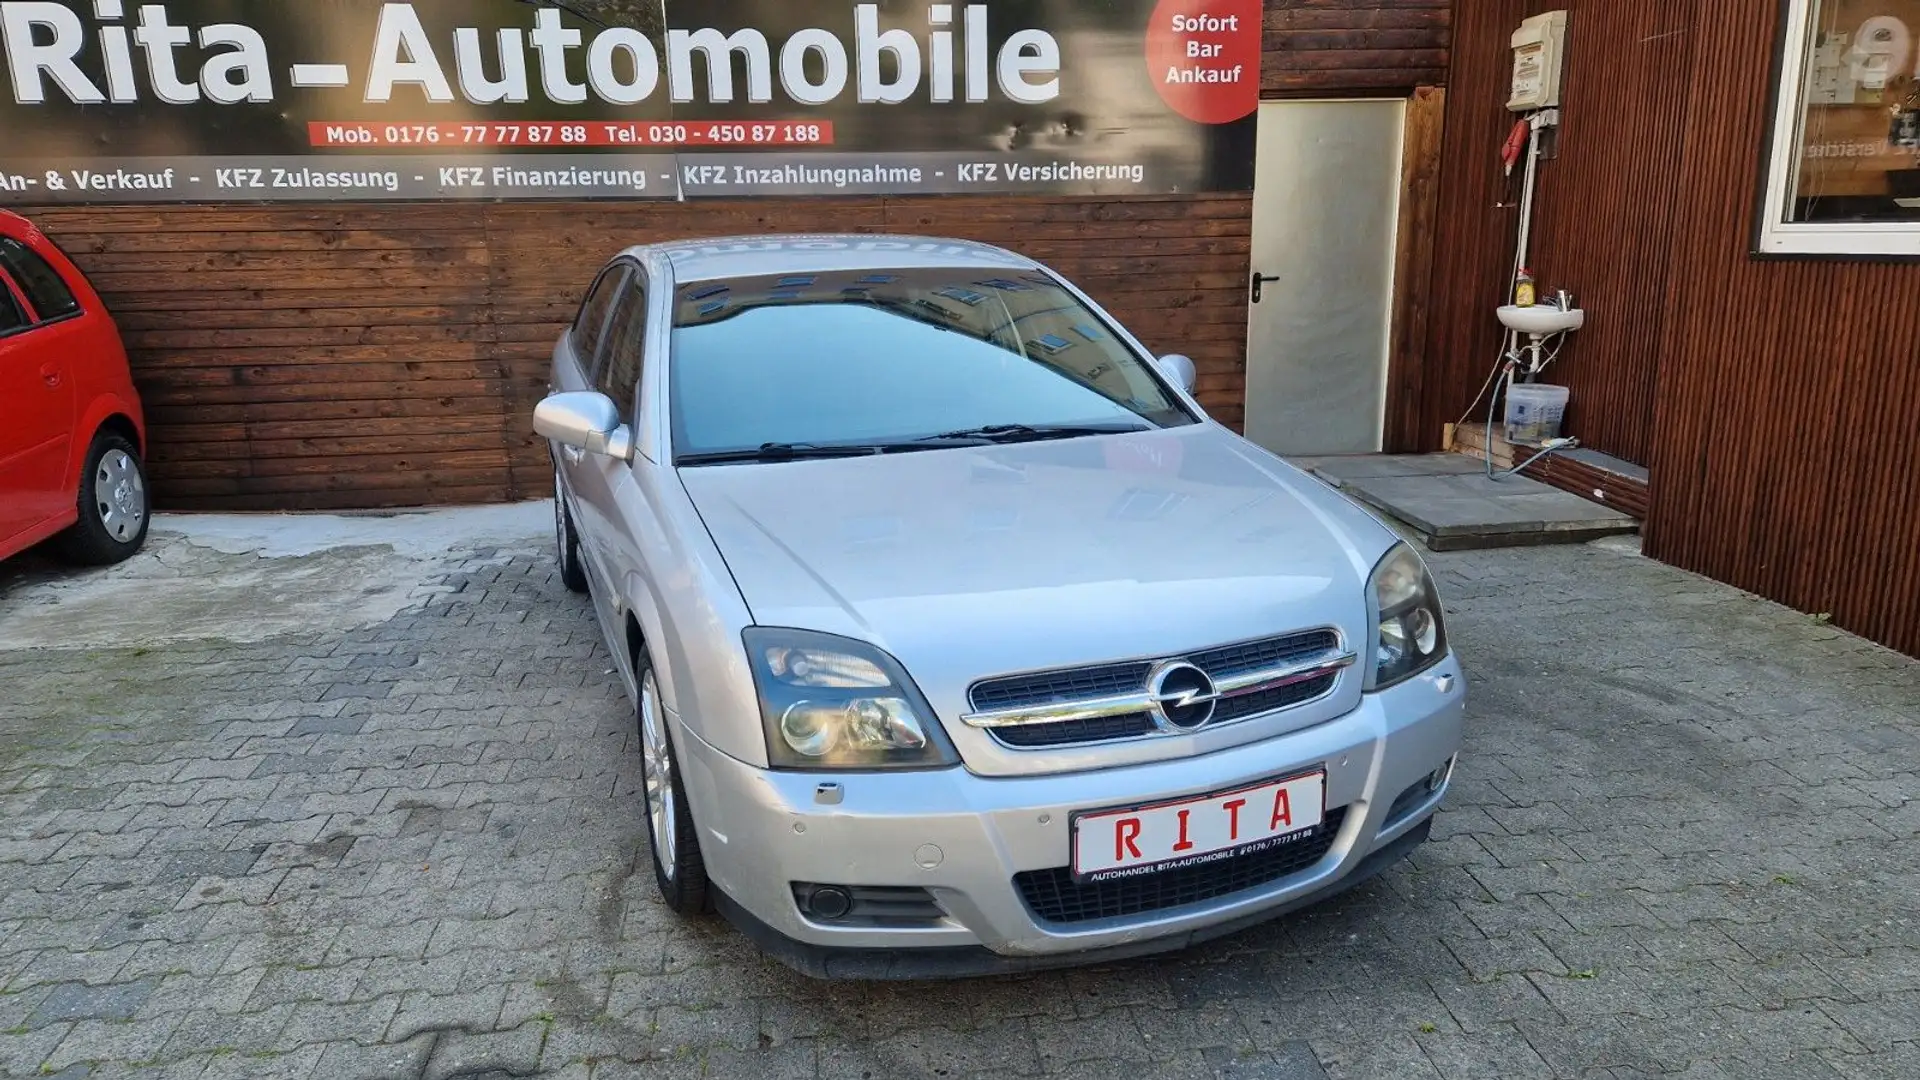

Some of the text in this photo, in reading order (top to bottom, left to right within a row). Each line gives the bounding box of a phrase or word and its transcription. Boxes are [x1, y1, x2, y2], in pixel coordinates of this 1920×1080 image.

[1171, 13, 1239, 32] Sofort
[1, 0, 274, 103] Rita
[362, 3, 1060, 105] Automobile
[1186, 40, 1223, 57] Bar
[1165, 64, 1242, 84] Ankauf
[326, 125, 378, 143] Mob.
[385, 125, 440, 143] 0176
[461, 125, 487, 143] 77
[494, 125, 520, 143] 77
[527, 125, 553, 143] 87
[560, 125, 587, 143] 88
[604, 124, 642, 142] Tel.
[649, 125, 686, 142] 030
[708, 124, 745, 142] 450
[751, 124, 776, 142] 87
[783, 124, 820, 142] 188
[45, 170, 67, 190] &
[71, 168, 174, 190] Verkauf
[215, 168, 265, 188] KFZ
[271, 168, 399, 191] Zulassung
[439, 167, 484, 187] KFZ
[492, 166, 646, 190] Finanzierung
[683, 165, 727, 185] KFZ
[733, 164, 922, 187] Inzahlungnahme
[957, 163, 998, 182] KFZ
[1004, 161, 1143, 183] Versicherung
[1091, 865, 1155, 881] AUTOHANDEL
